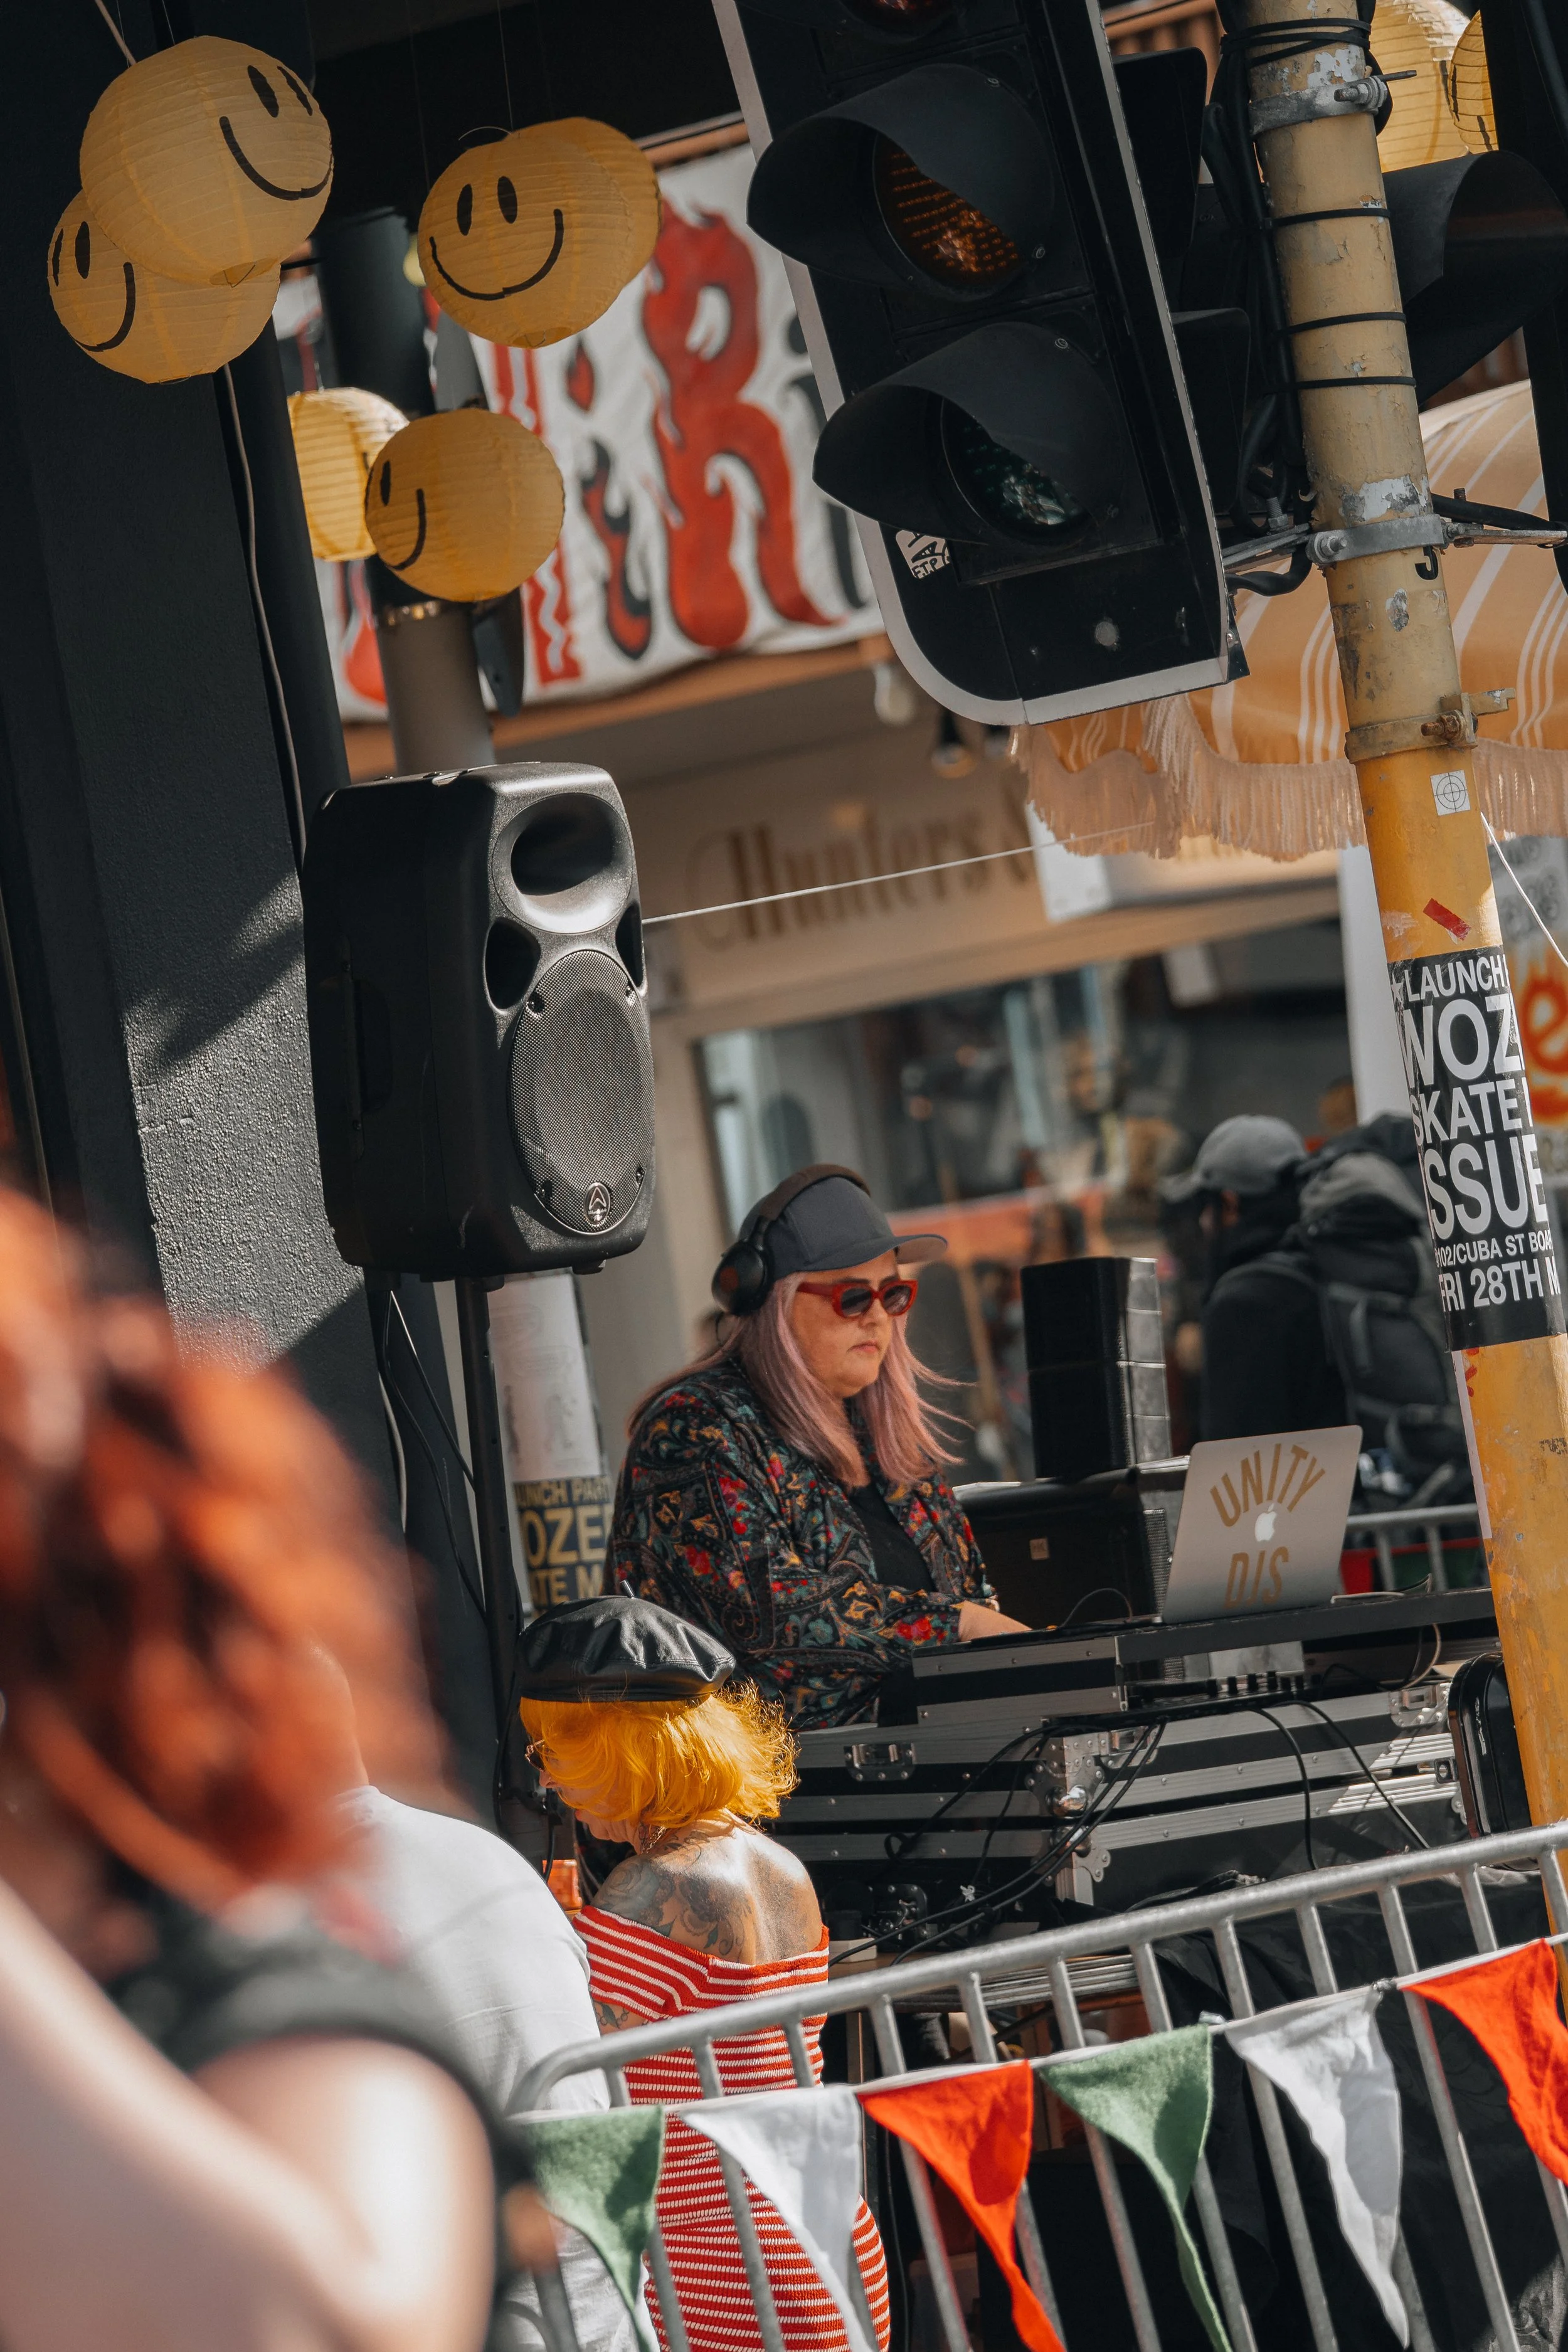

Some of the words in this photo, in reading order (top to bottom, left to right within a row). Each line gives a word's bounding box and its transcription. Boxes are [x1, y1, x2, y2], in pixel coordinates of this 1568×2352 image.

[1404, 955, 1505, 1002] LAUNCH
[1410, 1079, 1522, 1145] SKATE
[1505, 1233, 1525, 1256] ST
[1439, 1271, 1465, 1312] FRI
[1470, 1259, 1544, 1307] 28TH
[1209, 1443, 1325, 1527] UNITY
[1225, 1546, 1289, 1609] DJS
